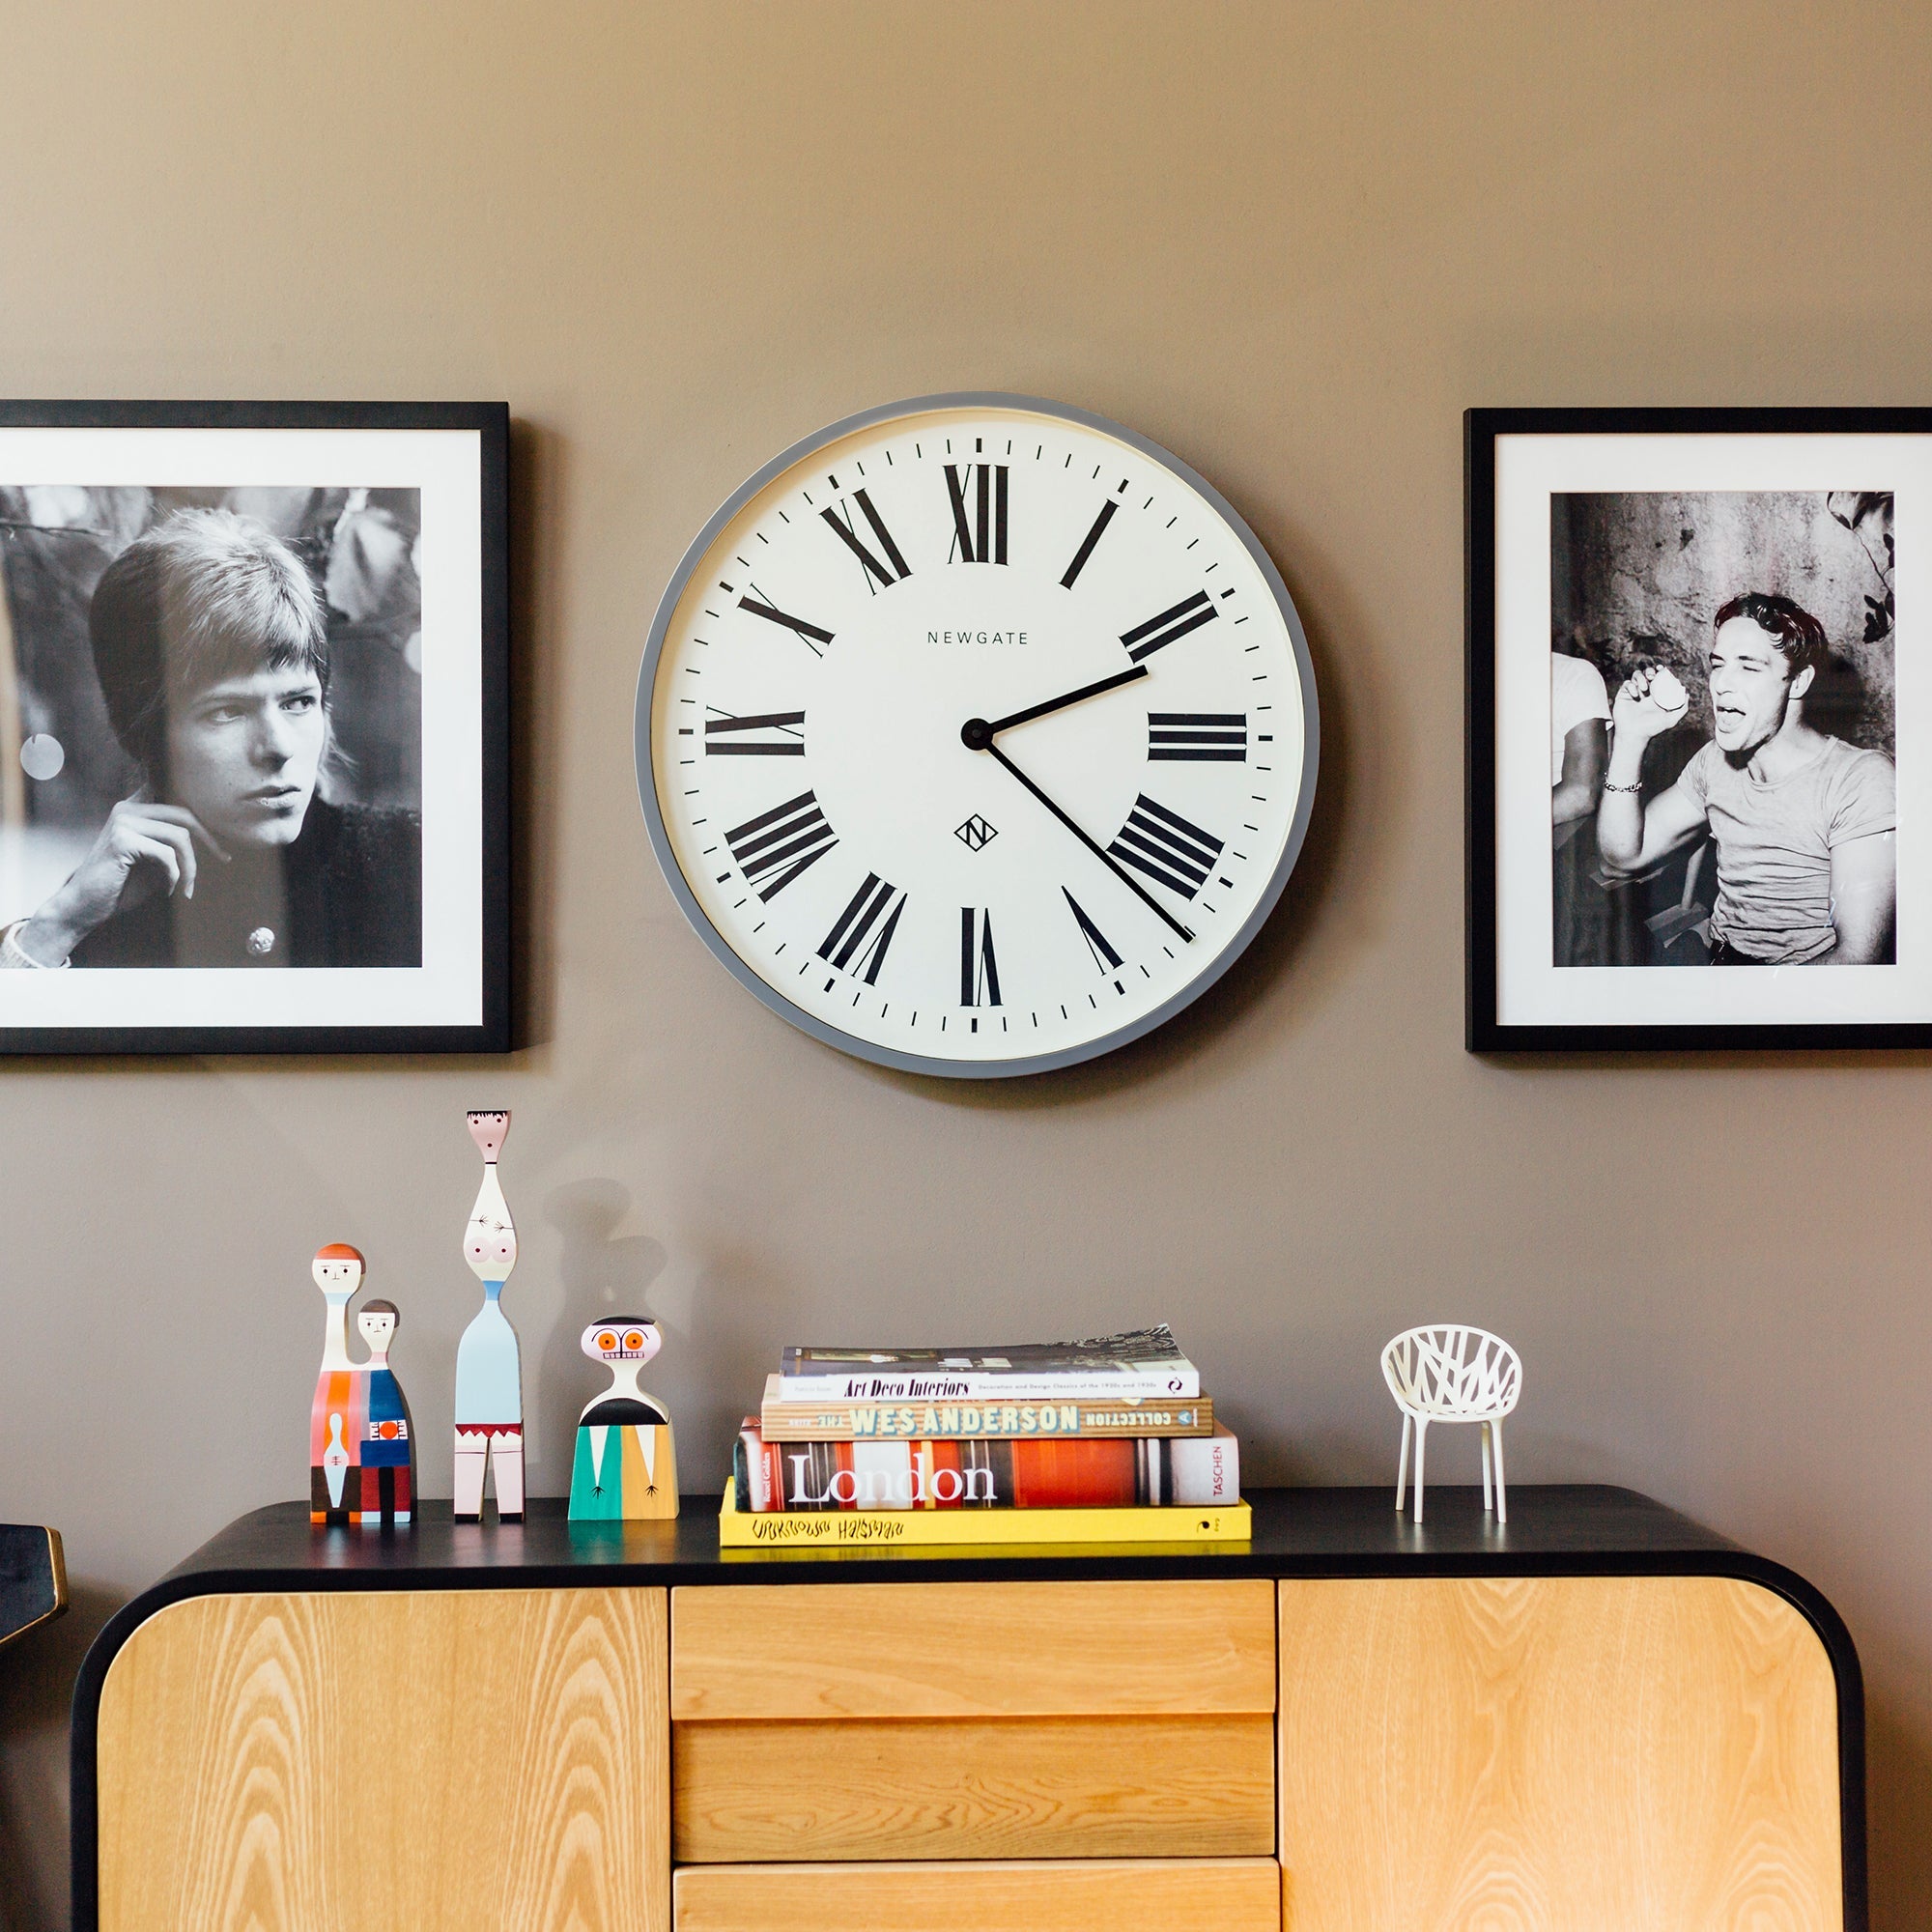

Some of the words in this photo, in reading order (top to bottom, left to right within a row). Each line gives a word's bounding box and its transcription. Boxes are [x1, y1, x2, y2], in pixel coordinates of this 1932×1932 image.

[820, 488, 912, 596] XI
[943, 465, 1009, 566] XII
[1059, 498, 1120, 590] I
[737, 583, 836, 658] X
[928, 632, 1029, 644] NEWGATE
[1119, 589, 1219, 664] II
[705, 706, 805, 756] IX
[1148, 712, 1247, 762] III
[724, 789, 839, 903] VIII
[1105, 792, 1226, 902] IIII
[815, 871, 907, 986] VII
[960, 907, 1003, 1007] VI
[1062, 885, 1124, 977] V
[817, 1414, 844, 1429] THE
[844, 1378, 867, 1398] Art
[870, 1378, 904, 1397] Deco
[908, 1378, 970, 1397] Interiors
[849, 1407, 918, 1436] WES
[923, 1406, 1080, 1435] ANDERSON
[1086, 1412, 1172, 1427] COLLECTION
[788, 1453, 998, 1503] London
[1213, 1446, 1223, 1496] TASCHEN
